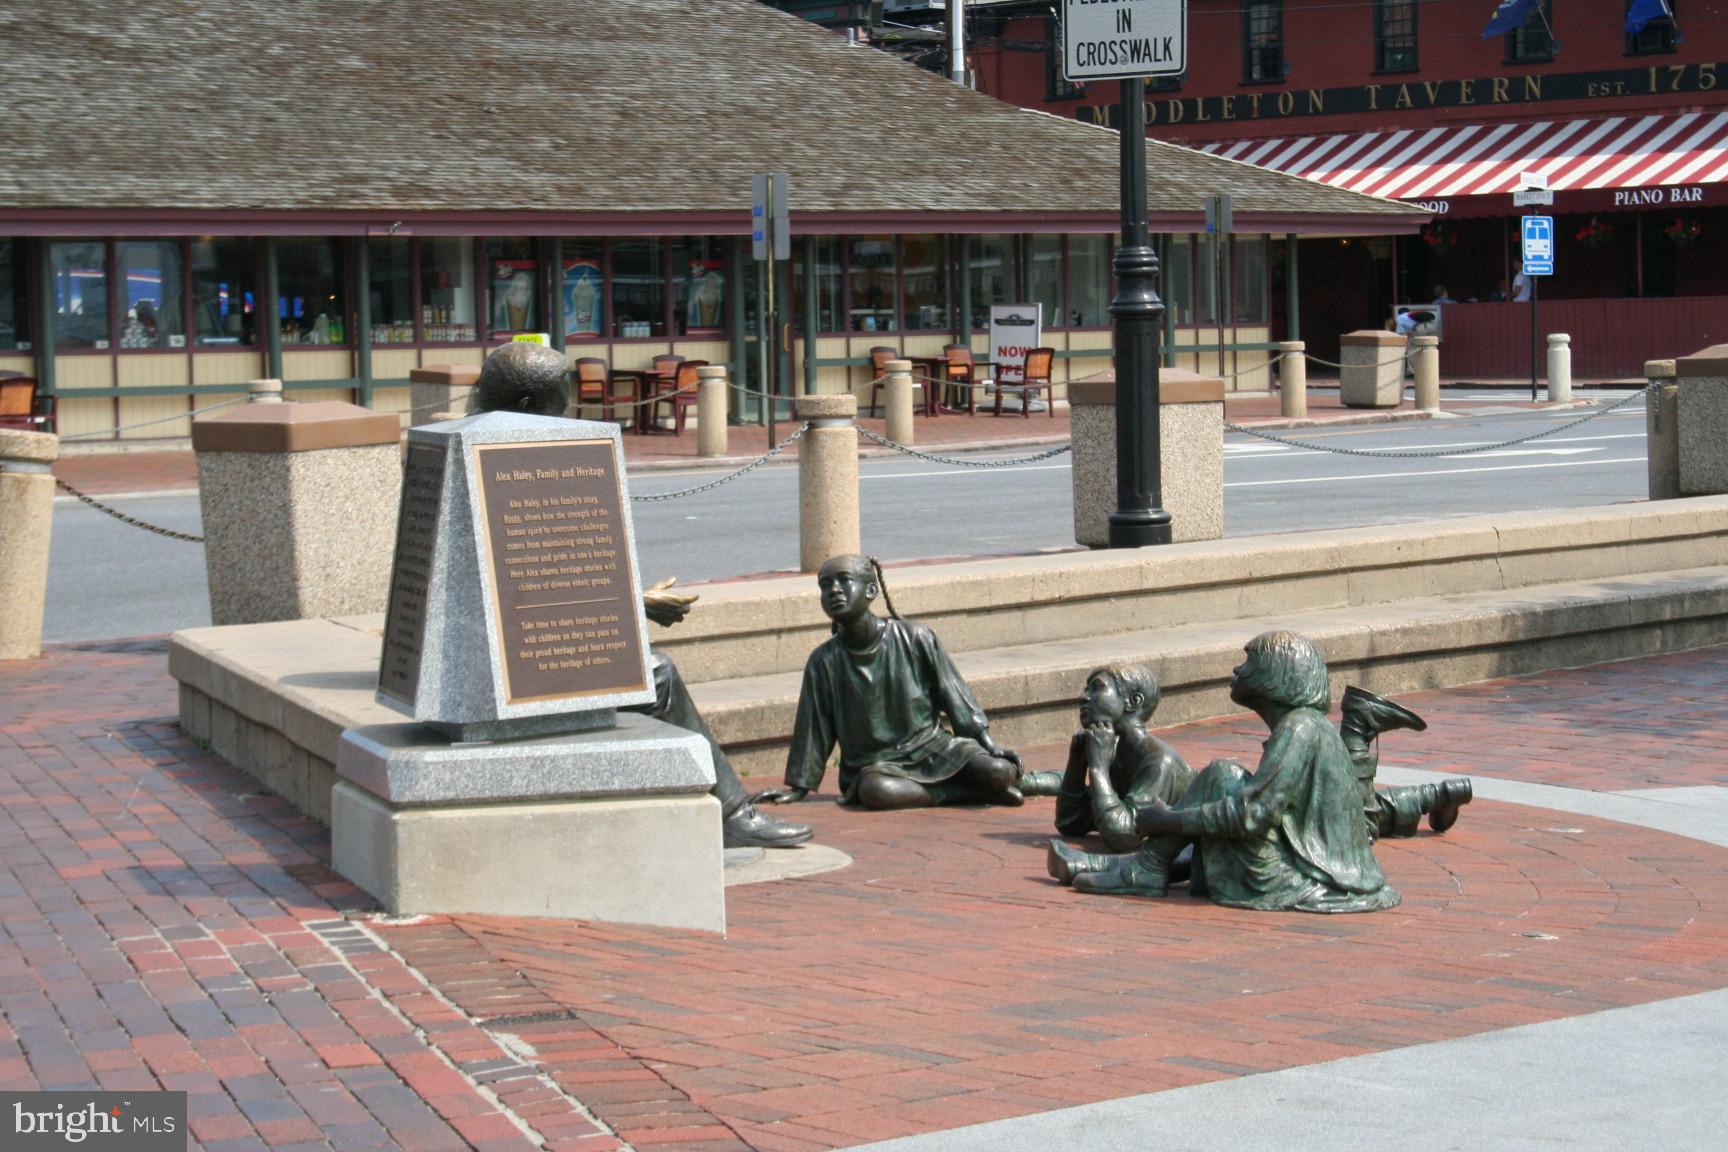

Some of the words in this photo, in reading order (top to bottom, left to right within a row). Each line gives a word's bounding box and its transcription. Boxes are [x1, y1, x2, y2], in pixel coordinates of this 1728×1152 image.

[1116, 8, 1132, 33] IN
[1076, 37, 1172, 67] CROSSWALK
[1092, 88, 1325, 127] MDDLETON
[1364, 75, 1545, 110] TAVERN
[1588, 82, 1631, 97] EST.
[1614, 189, 1664, 206] PIANO
[1670, 188, 1703, 203] BAR
[998, 346, 1032, 358] NOW
[496, 471, 511, 482] Alex
[513, 470, 534, 481] Haley,
[536, 469, 559, 480] Family
[561, 468, 574, 478] and
[576, 466, 605, 478] Heritage
[510, 500, 521, 509] Alex
[521, 621, 535, 631] Take
